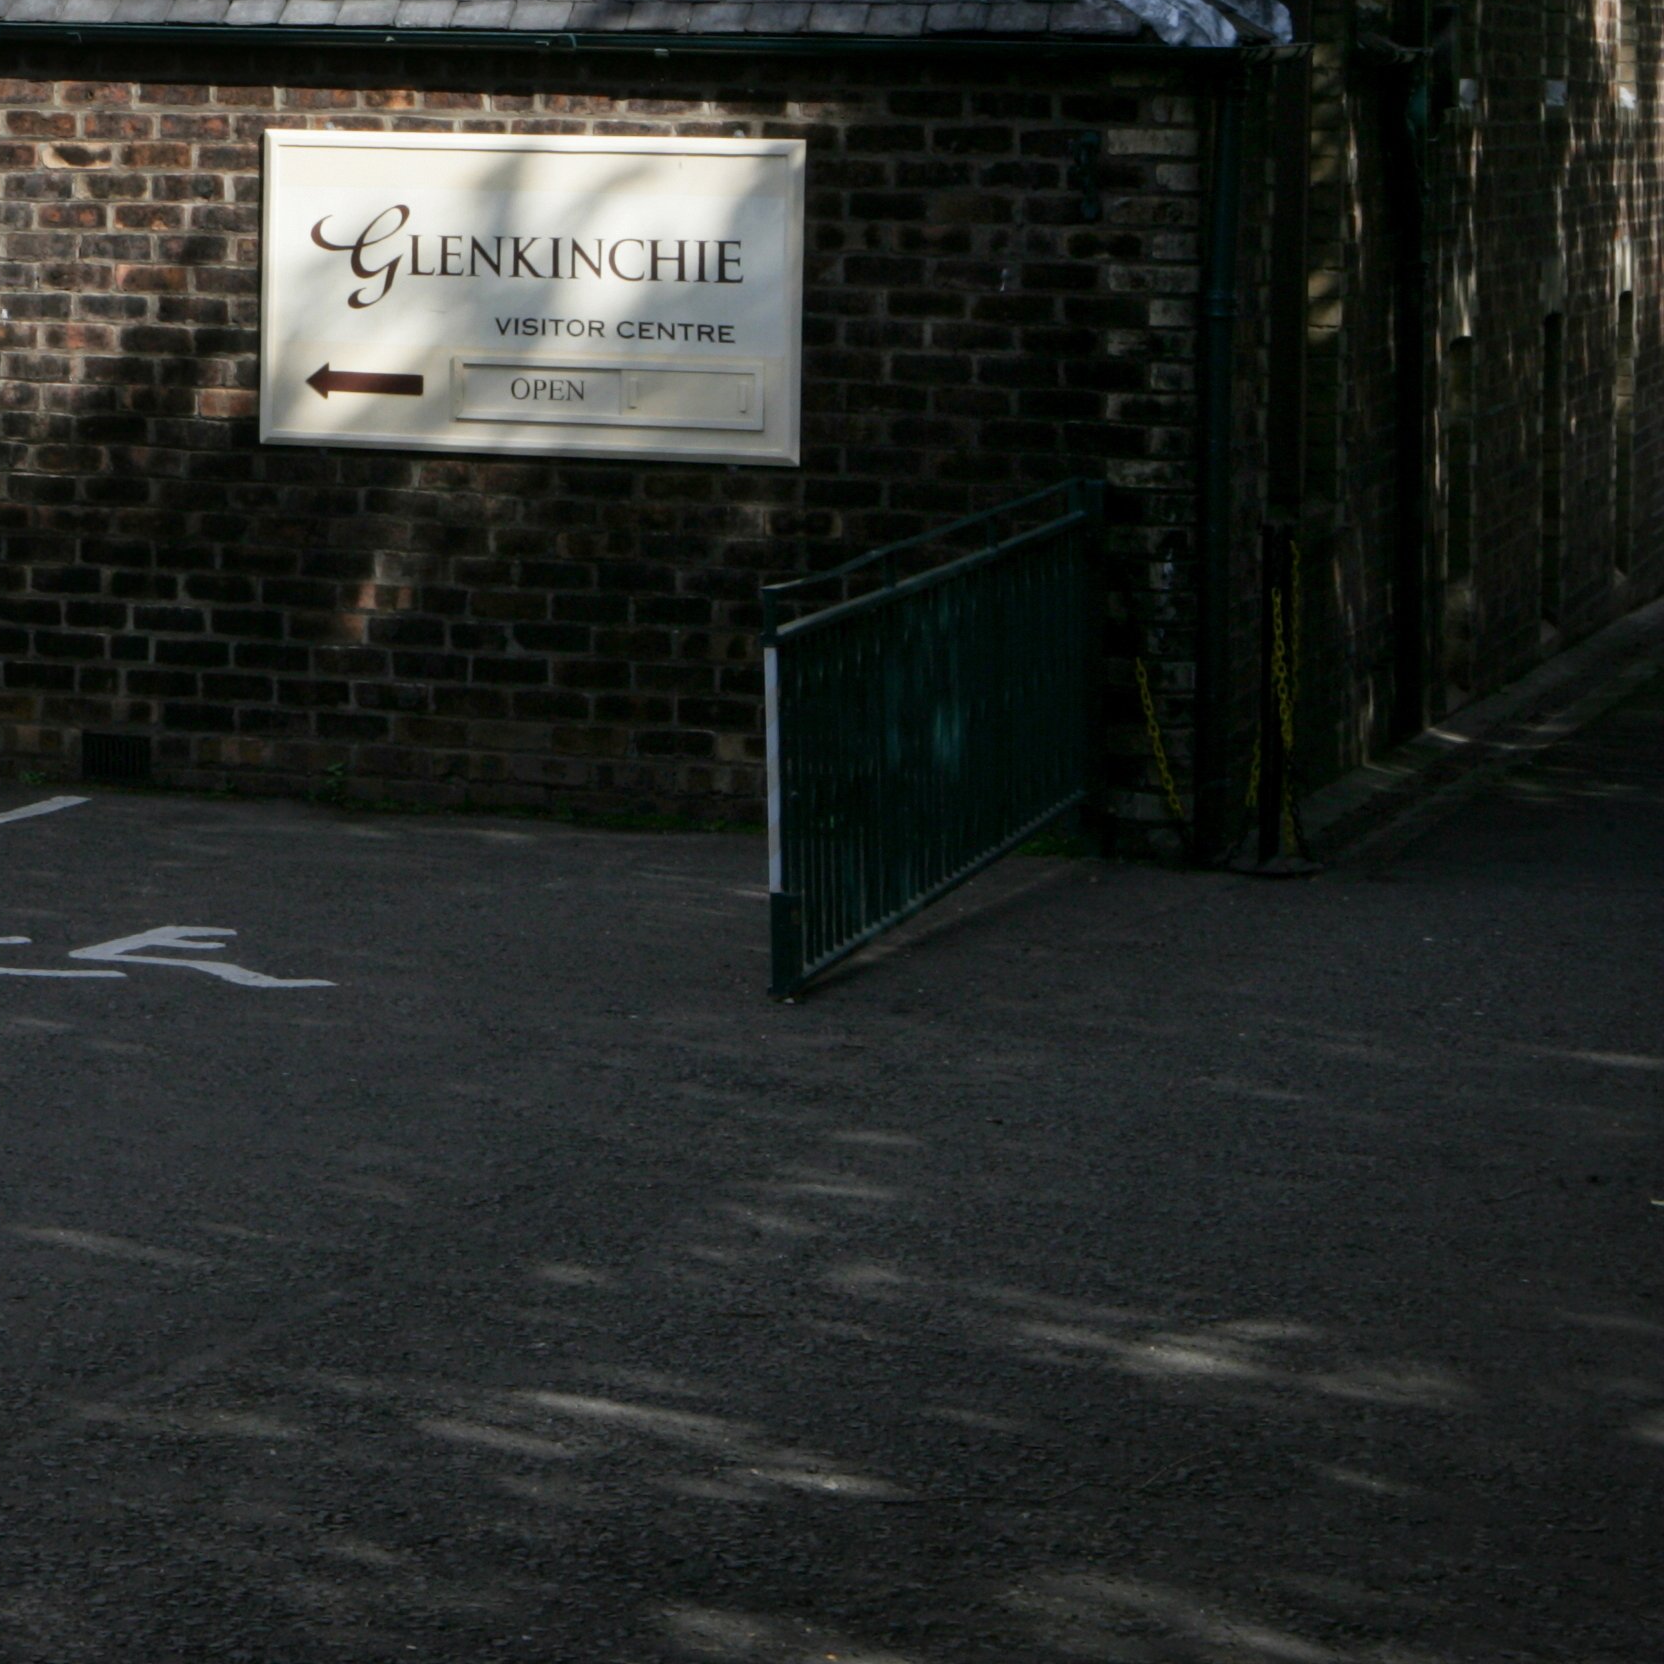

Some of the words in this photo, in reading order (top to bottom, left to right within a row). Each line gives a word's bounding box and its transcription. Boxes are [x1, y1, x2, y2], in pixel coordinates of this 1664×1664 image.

[310, 204, 745, 309] GLENKINCHIE
[494, 317, 606, 338] VISITOR
[615, 320, 736, 343] CENTRE
[510, 377, 585, 402] OPEN
